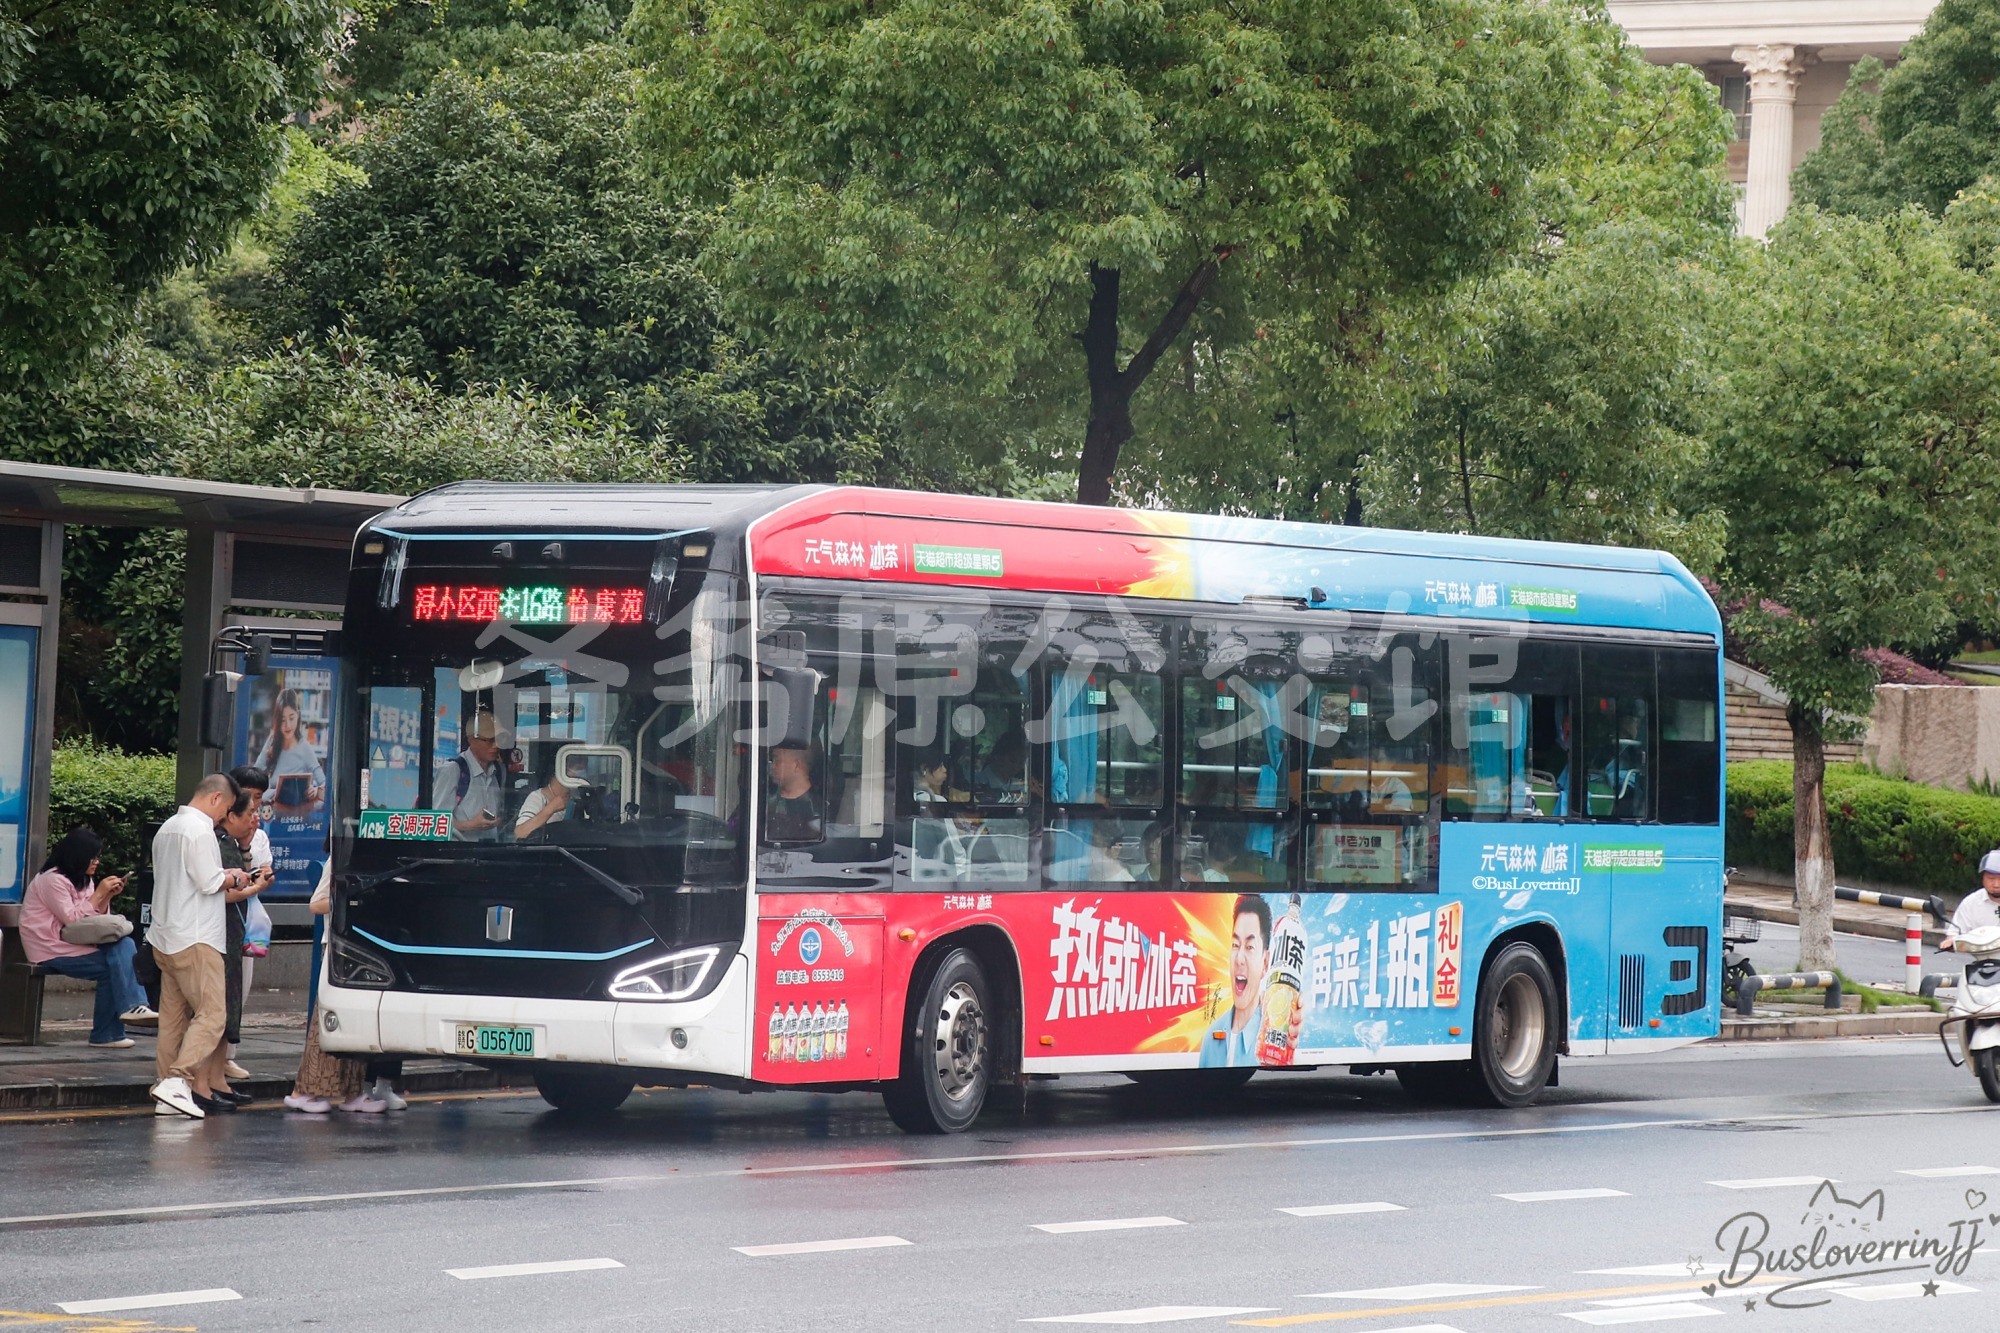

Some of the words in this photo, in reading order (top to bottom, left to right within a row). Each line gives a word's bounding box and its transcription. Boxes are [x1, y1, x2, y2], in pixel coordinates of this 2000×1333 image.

[804, 538, 865, 568] 元气森林
[869, 540, 899, 570] 冰茶
[915, 549, 1001, 572] 天猫超市超级星期5
[520, 586, 563, 622] 16路
[567, 587, 645, 623] 怡康苑
[1424, 580, 1472, 606] 元气森林
[1510, 588, 1577, 610] 天猫超市超级星期5
[387, 813, 450, 838] 空调开启
[1481, 844, 1537, 872] 元气森林
[1540, 842, 1568, 874] 冰茶
[1583, 848, 1664, 869] 天猫超市超级星期5
[943, 895, 975, 910] 元气森林
[1045, 897, 1198, 1021] 热就冰茶
[1271, 928, 1306, 976] 冰茶
[1310, 910, 1432, 1009] 再来1瓶
[1436, 909, 1459, 1001] 礼金
